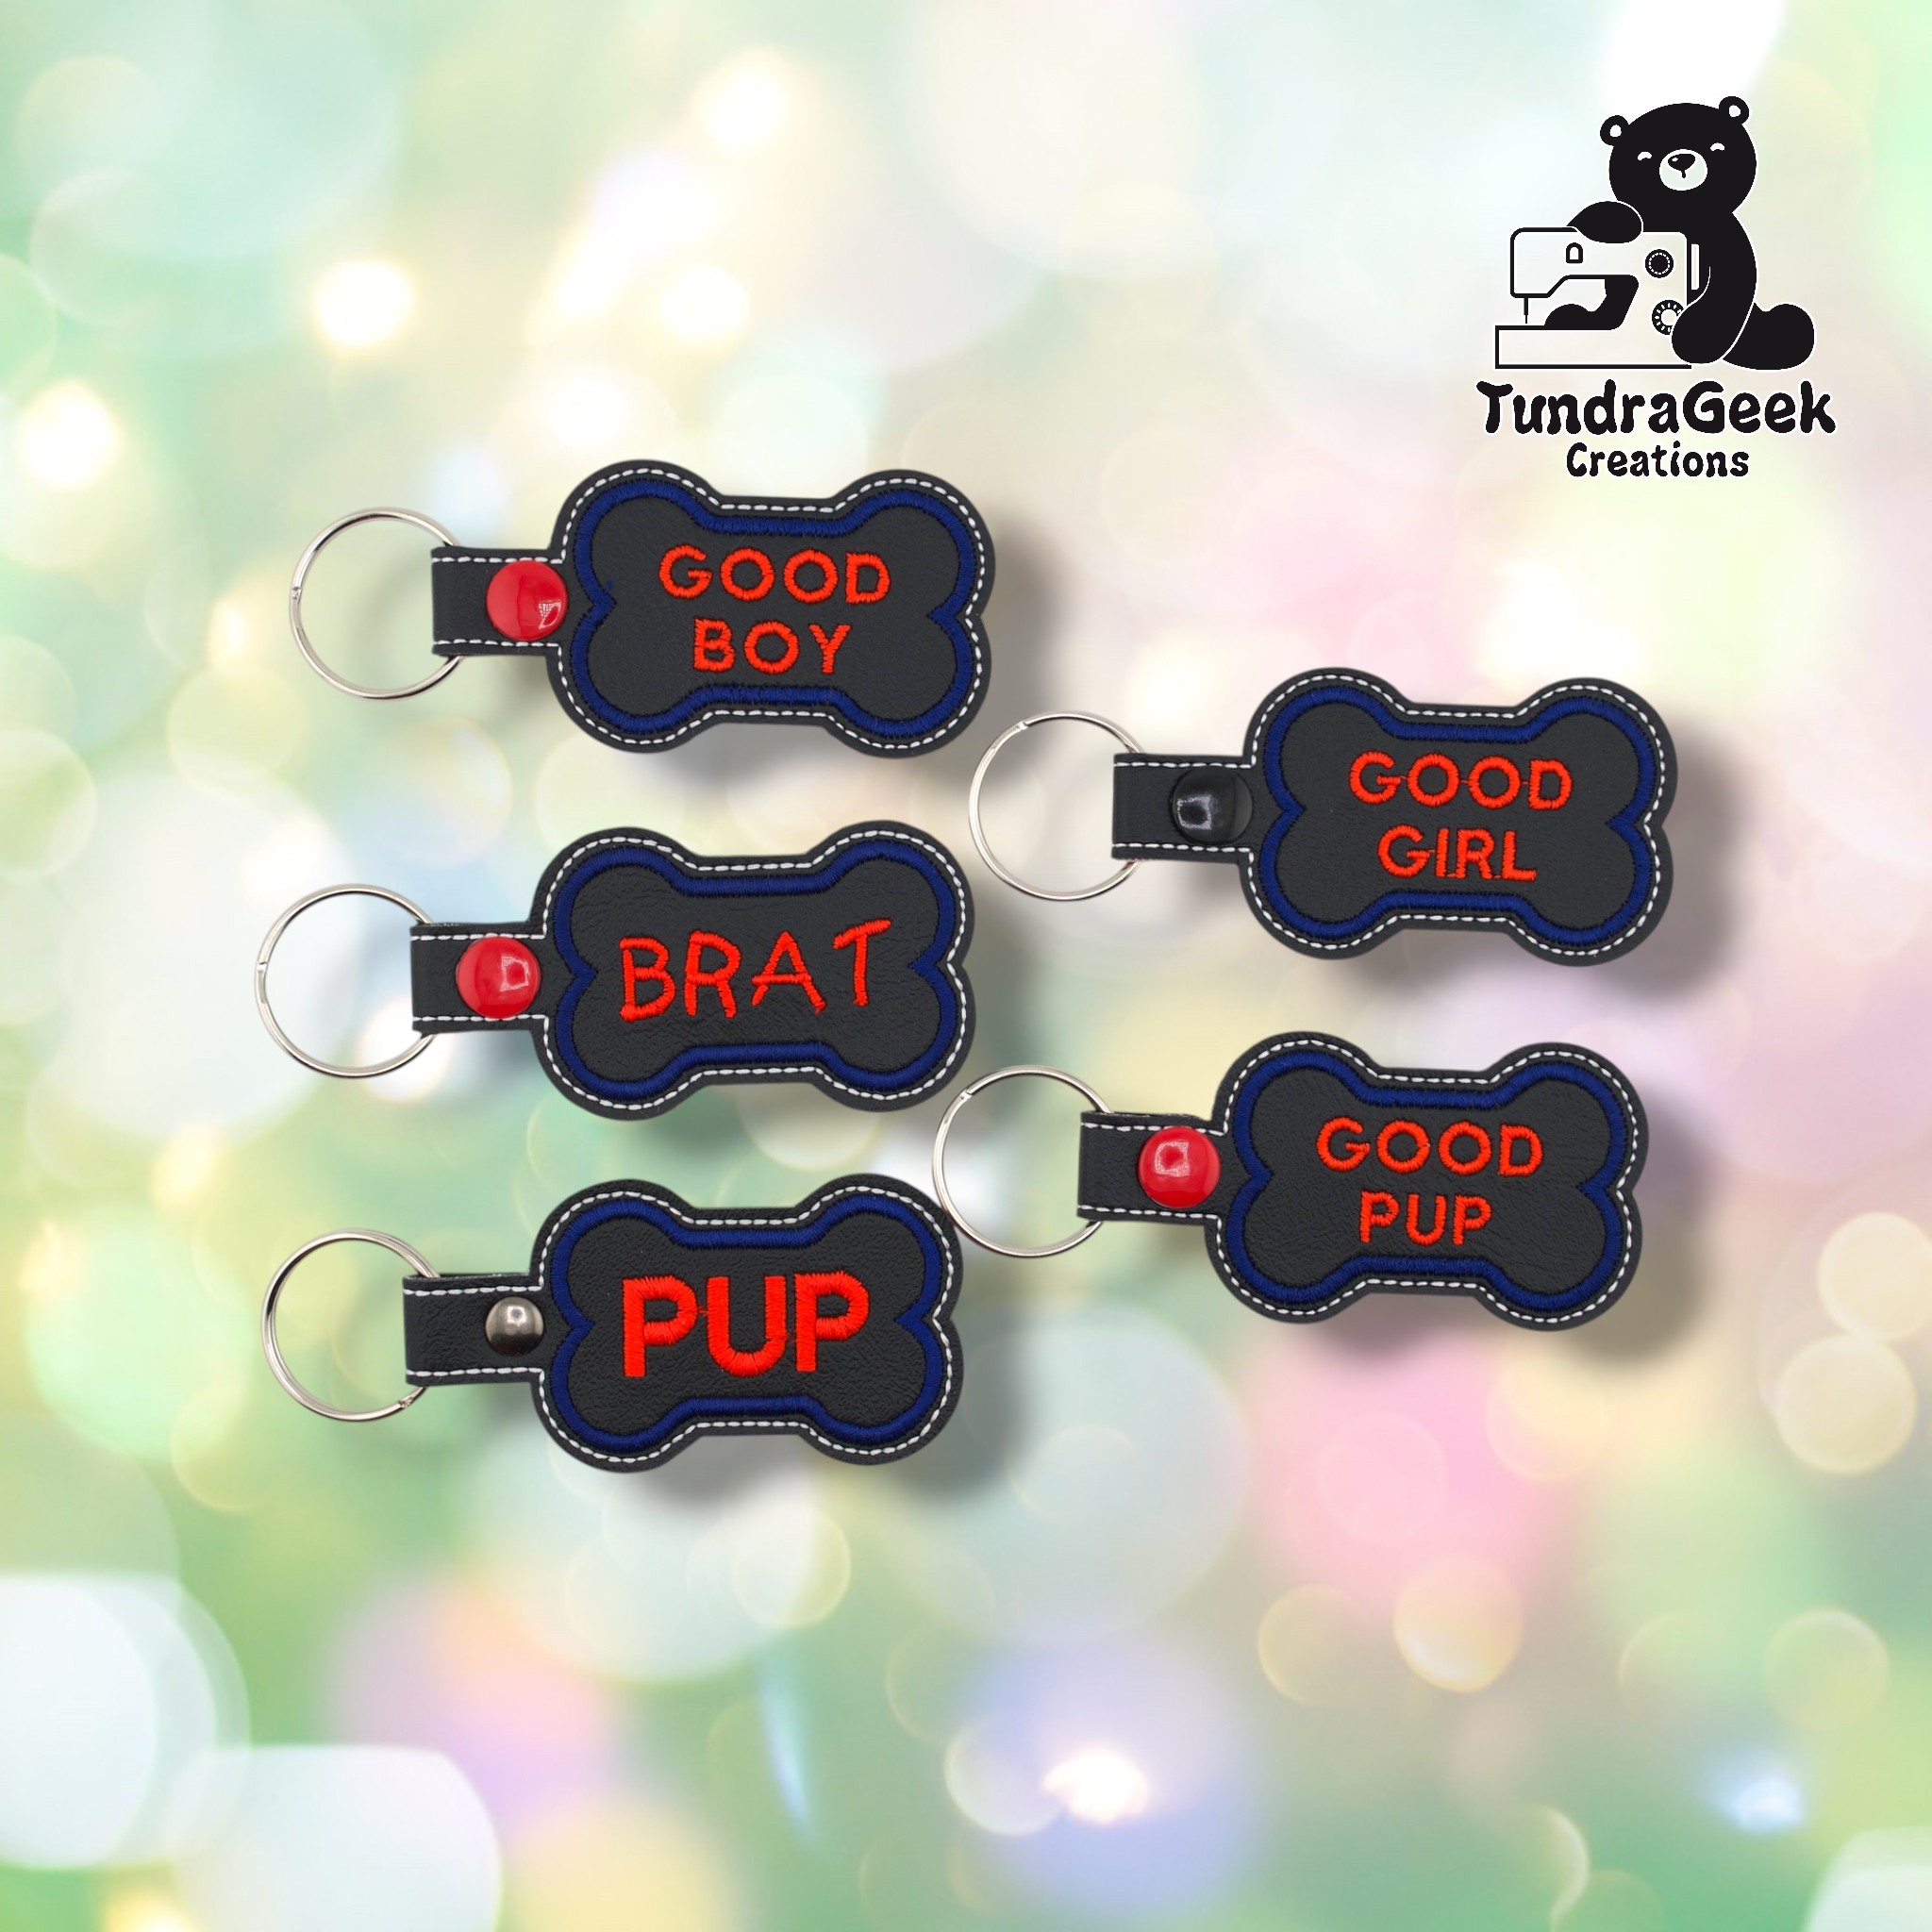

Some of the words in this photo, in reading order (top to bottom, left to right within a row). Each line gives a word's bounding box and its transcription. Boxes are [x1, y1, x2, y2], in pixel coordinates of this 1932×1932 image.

[658, 544, 891, 605] GOOD
[693, 618, 852, 675] BOY
[1349, 751, 1574, 811] GOOD
[1377, 824, 1538, 882] GIRL
[618, 919, 891, 1024] BRAT
[1316, 1117, 1543, 1177] GOOD
[1359, 1191, 1492, 1246] PUP
[623, 1270, 870, 1378] PUP
